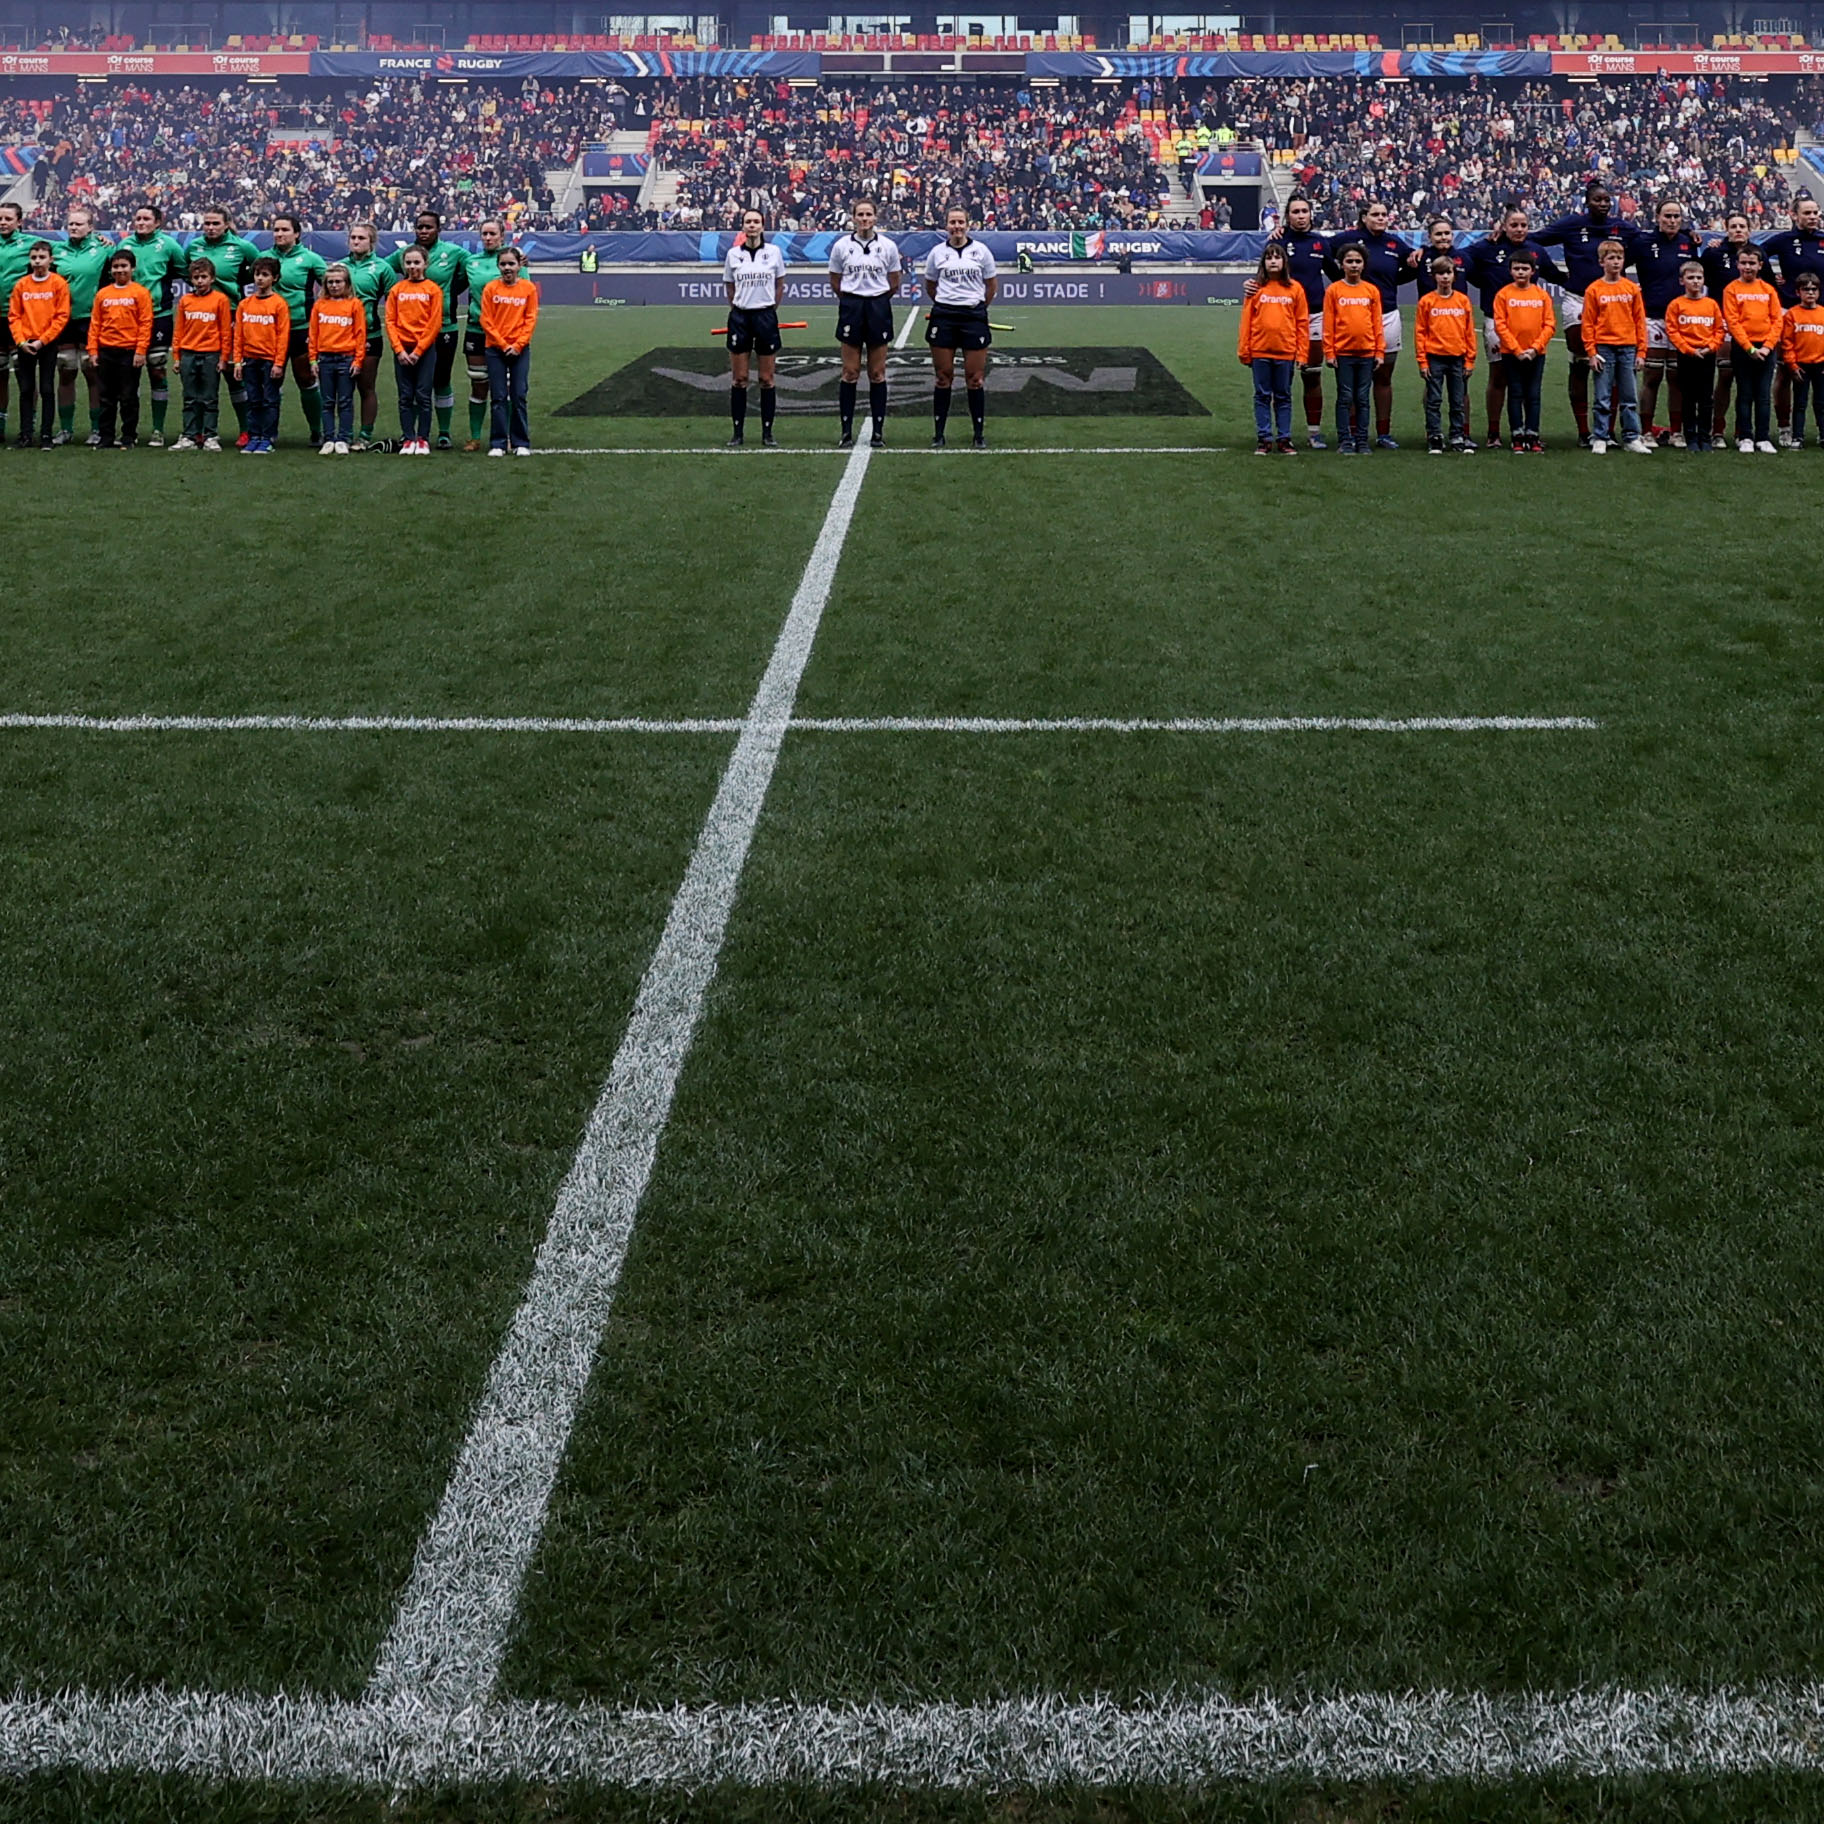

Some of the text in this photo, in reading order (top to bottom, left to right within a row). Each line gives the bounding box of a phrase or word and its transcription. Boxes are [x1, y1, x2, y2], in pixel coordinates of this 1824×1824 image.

[18, 56, 48, 64] course
[124, 56, 154, 64] course
[229, 56, 259, 64] course
[379, 58, 502, 69] FRANCE RUGBY
[1017, 242, 1162, 253] FRANC RUGBY
[678, 283, 728, 298] TENT
[1003, 283, 1027, 298] DU
[1033, 283, 1088, 298] STADE
[1099, 283, 1104, 298] !
[493, 295, 526, 306] Orange
[1260, 294, 1292, 304] Orange
[1509, 298, 1543, 307] Orange
[1431, 308, 1464, 316] Orange
[775, 355, 1068, 365] GRATESS
